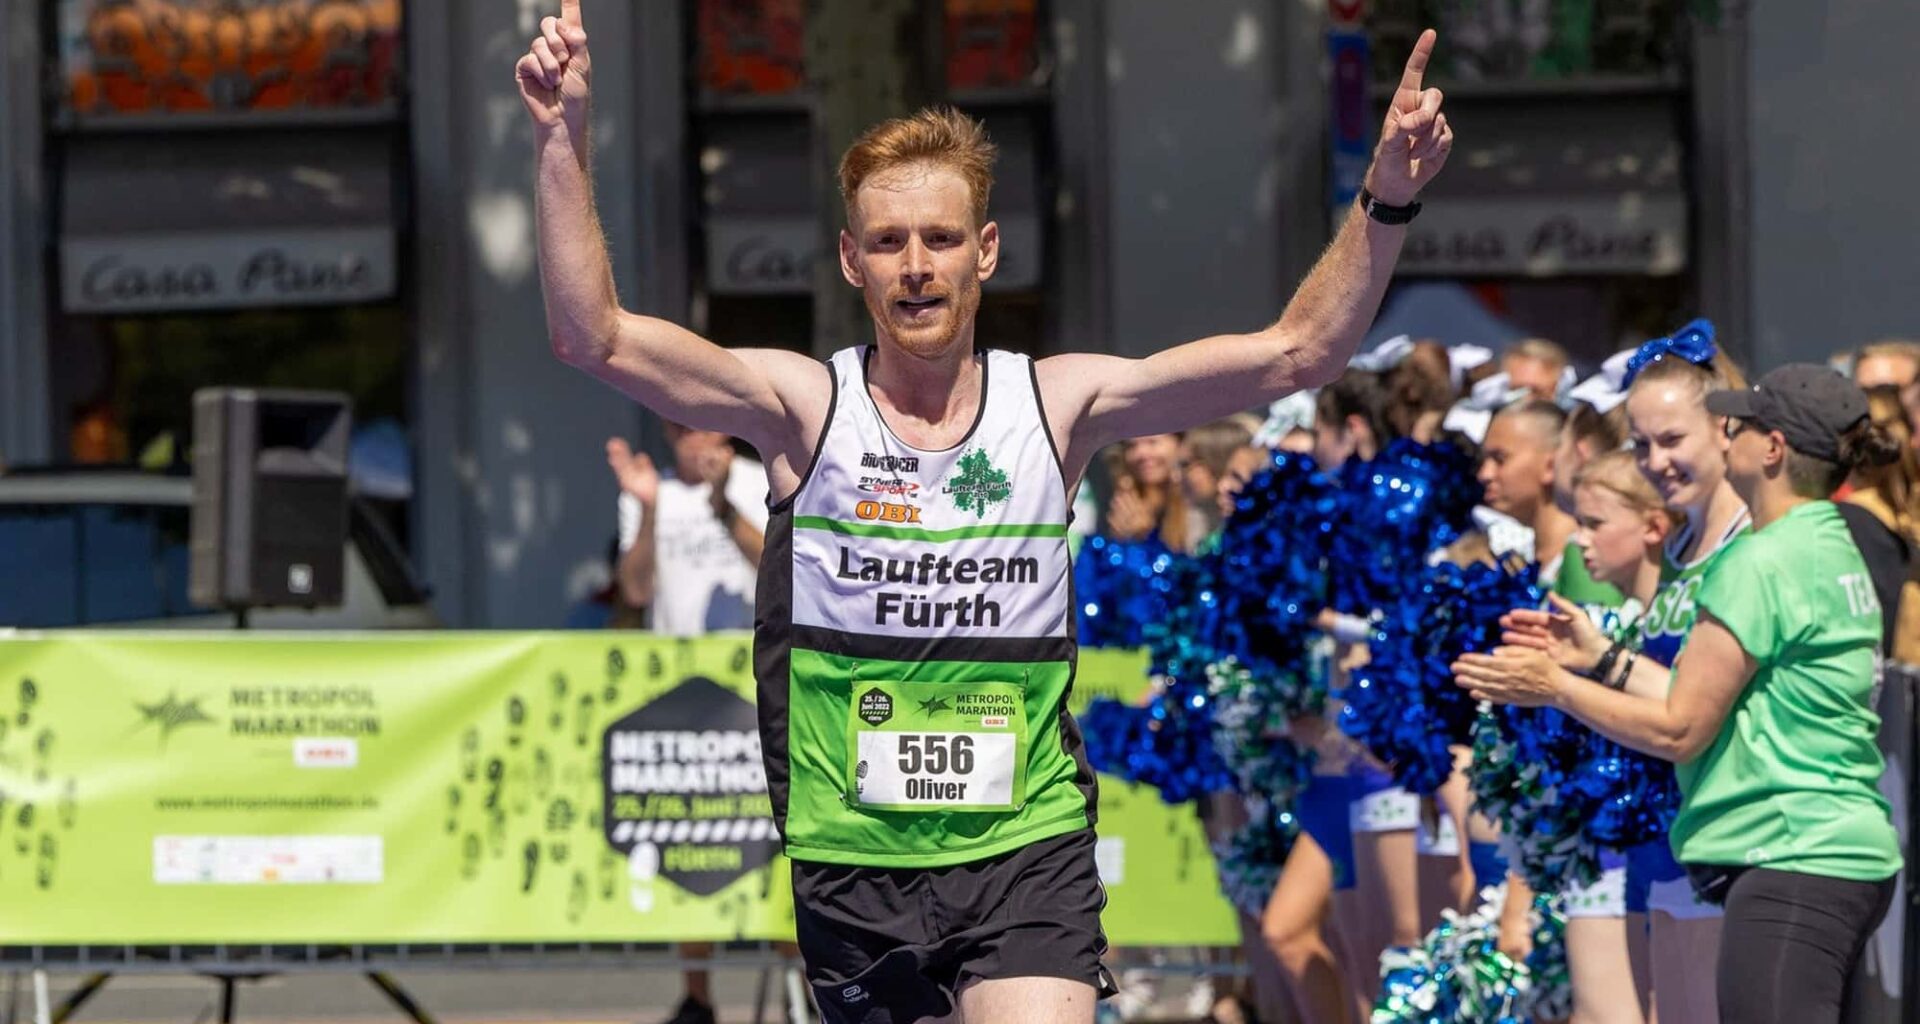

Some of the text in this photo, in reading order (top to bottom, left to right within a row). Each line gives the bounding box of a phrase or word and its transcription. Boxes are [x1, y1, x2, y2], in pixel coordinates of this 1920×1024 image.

[727, 236, 812, 282] Ca
[1403, 229, 1506, 262] asa
[81, 252, 217, 301] Casa
[942, 482, 983, 494] Laufteam
[855, 500, 922, 523] OBI
[837, 546, 1039, 586] Laufteam
[875, 592, 1000, 628] Fürth
[230, 688, 376, 708] METROPOL
[956, 694, 1014, 704] METROPOL
[956, 706, 1015, 716] MARATHON
[230, 717, 381, 737] MARATHON
[610, 730, 763, 762] METROPO
[898, 735, 974, 774] 556
[611, 762, 768, 792] MARATHO
[905, 778, 967, 800] Oliver
